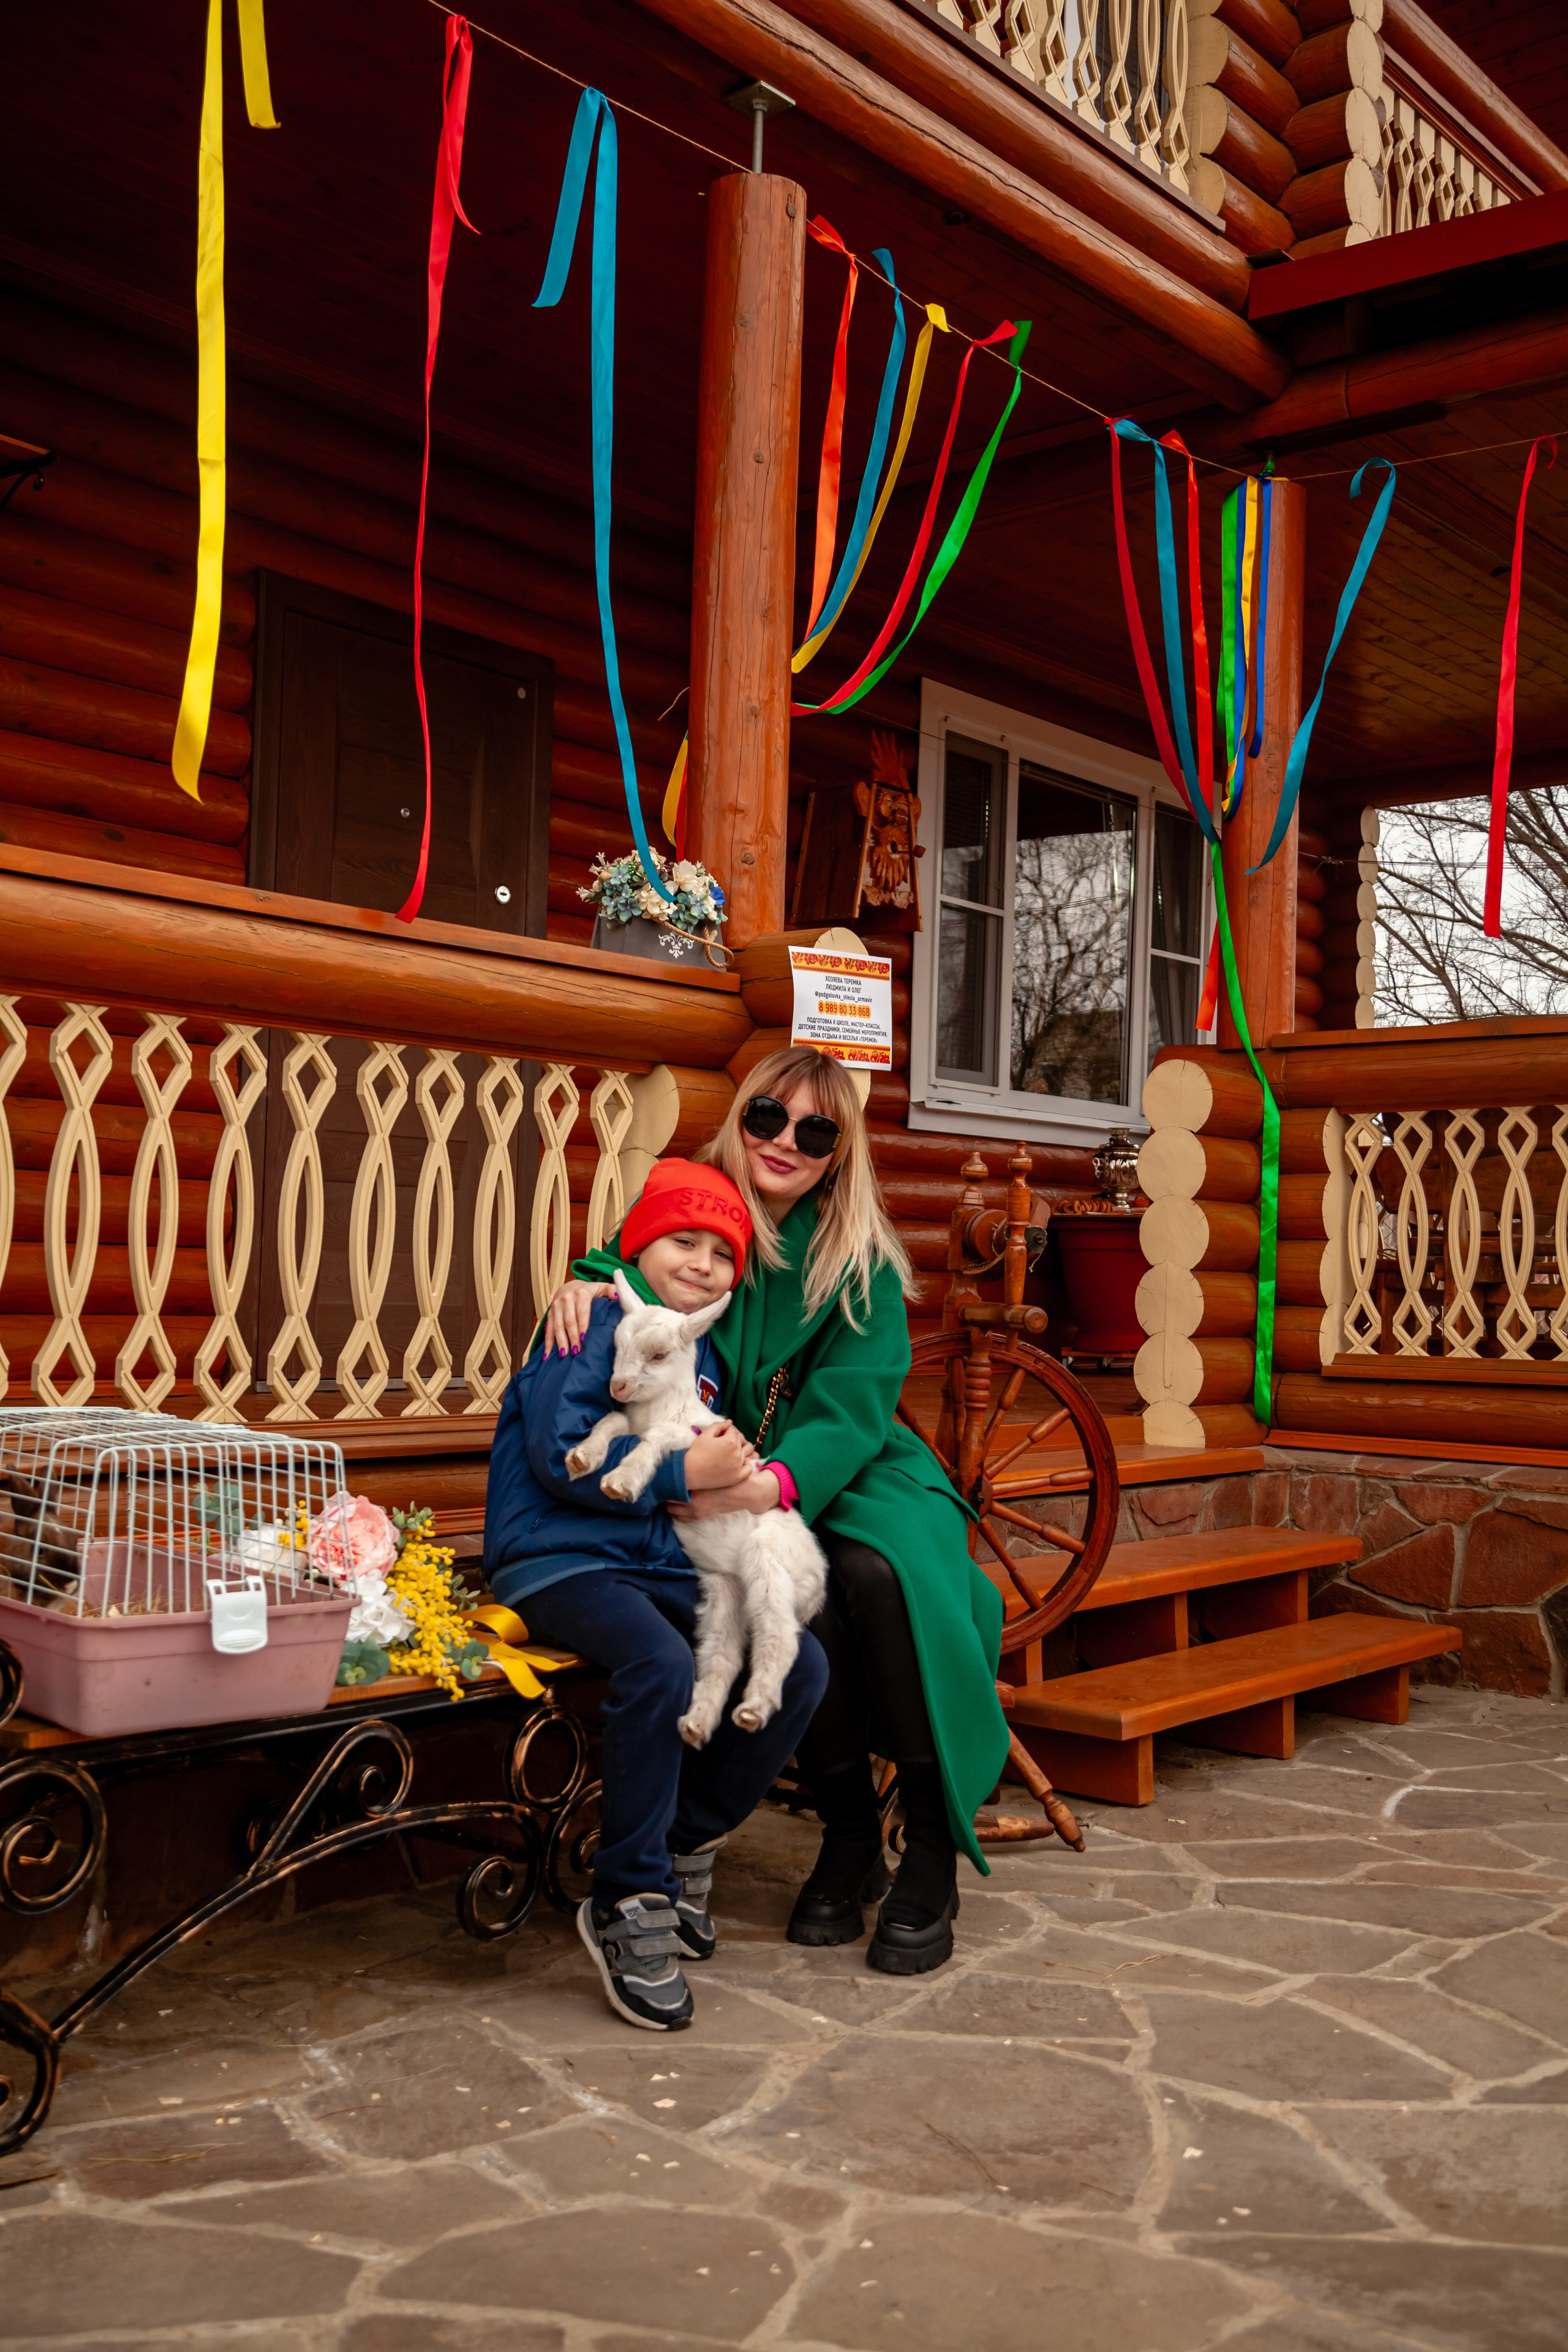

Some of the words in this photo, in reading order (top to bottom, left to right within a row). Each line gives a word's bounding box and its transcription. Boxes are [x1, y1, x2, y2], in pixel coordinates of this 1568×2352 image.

[815, 990, 873, 1003] @podgotovka_shkola_armavir
[819, 1002, 823, 1011] 8
[825, 1003, 837, 1013] 989
[839, 1005, 847, 1014] 80
[849, 1006, 856, 1015] 33
[858, 1007, 870, 1017] 868
[851, 1021, 881, 1030] МАСТЕР-КЛАССЫ,
